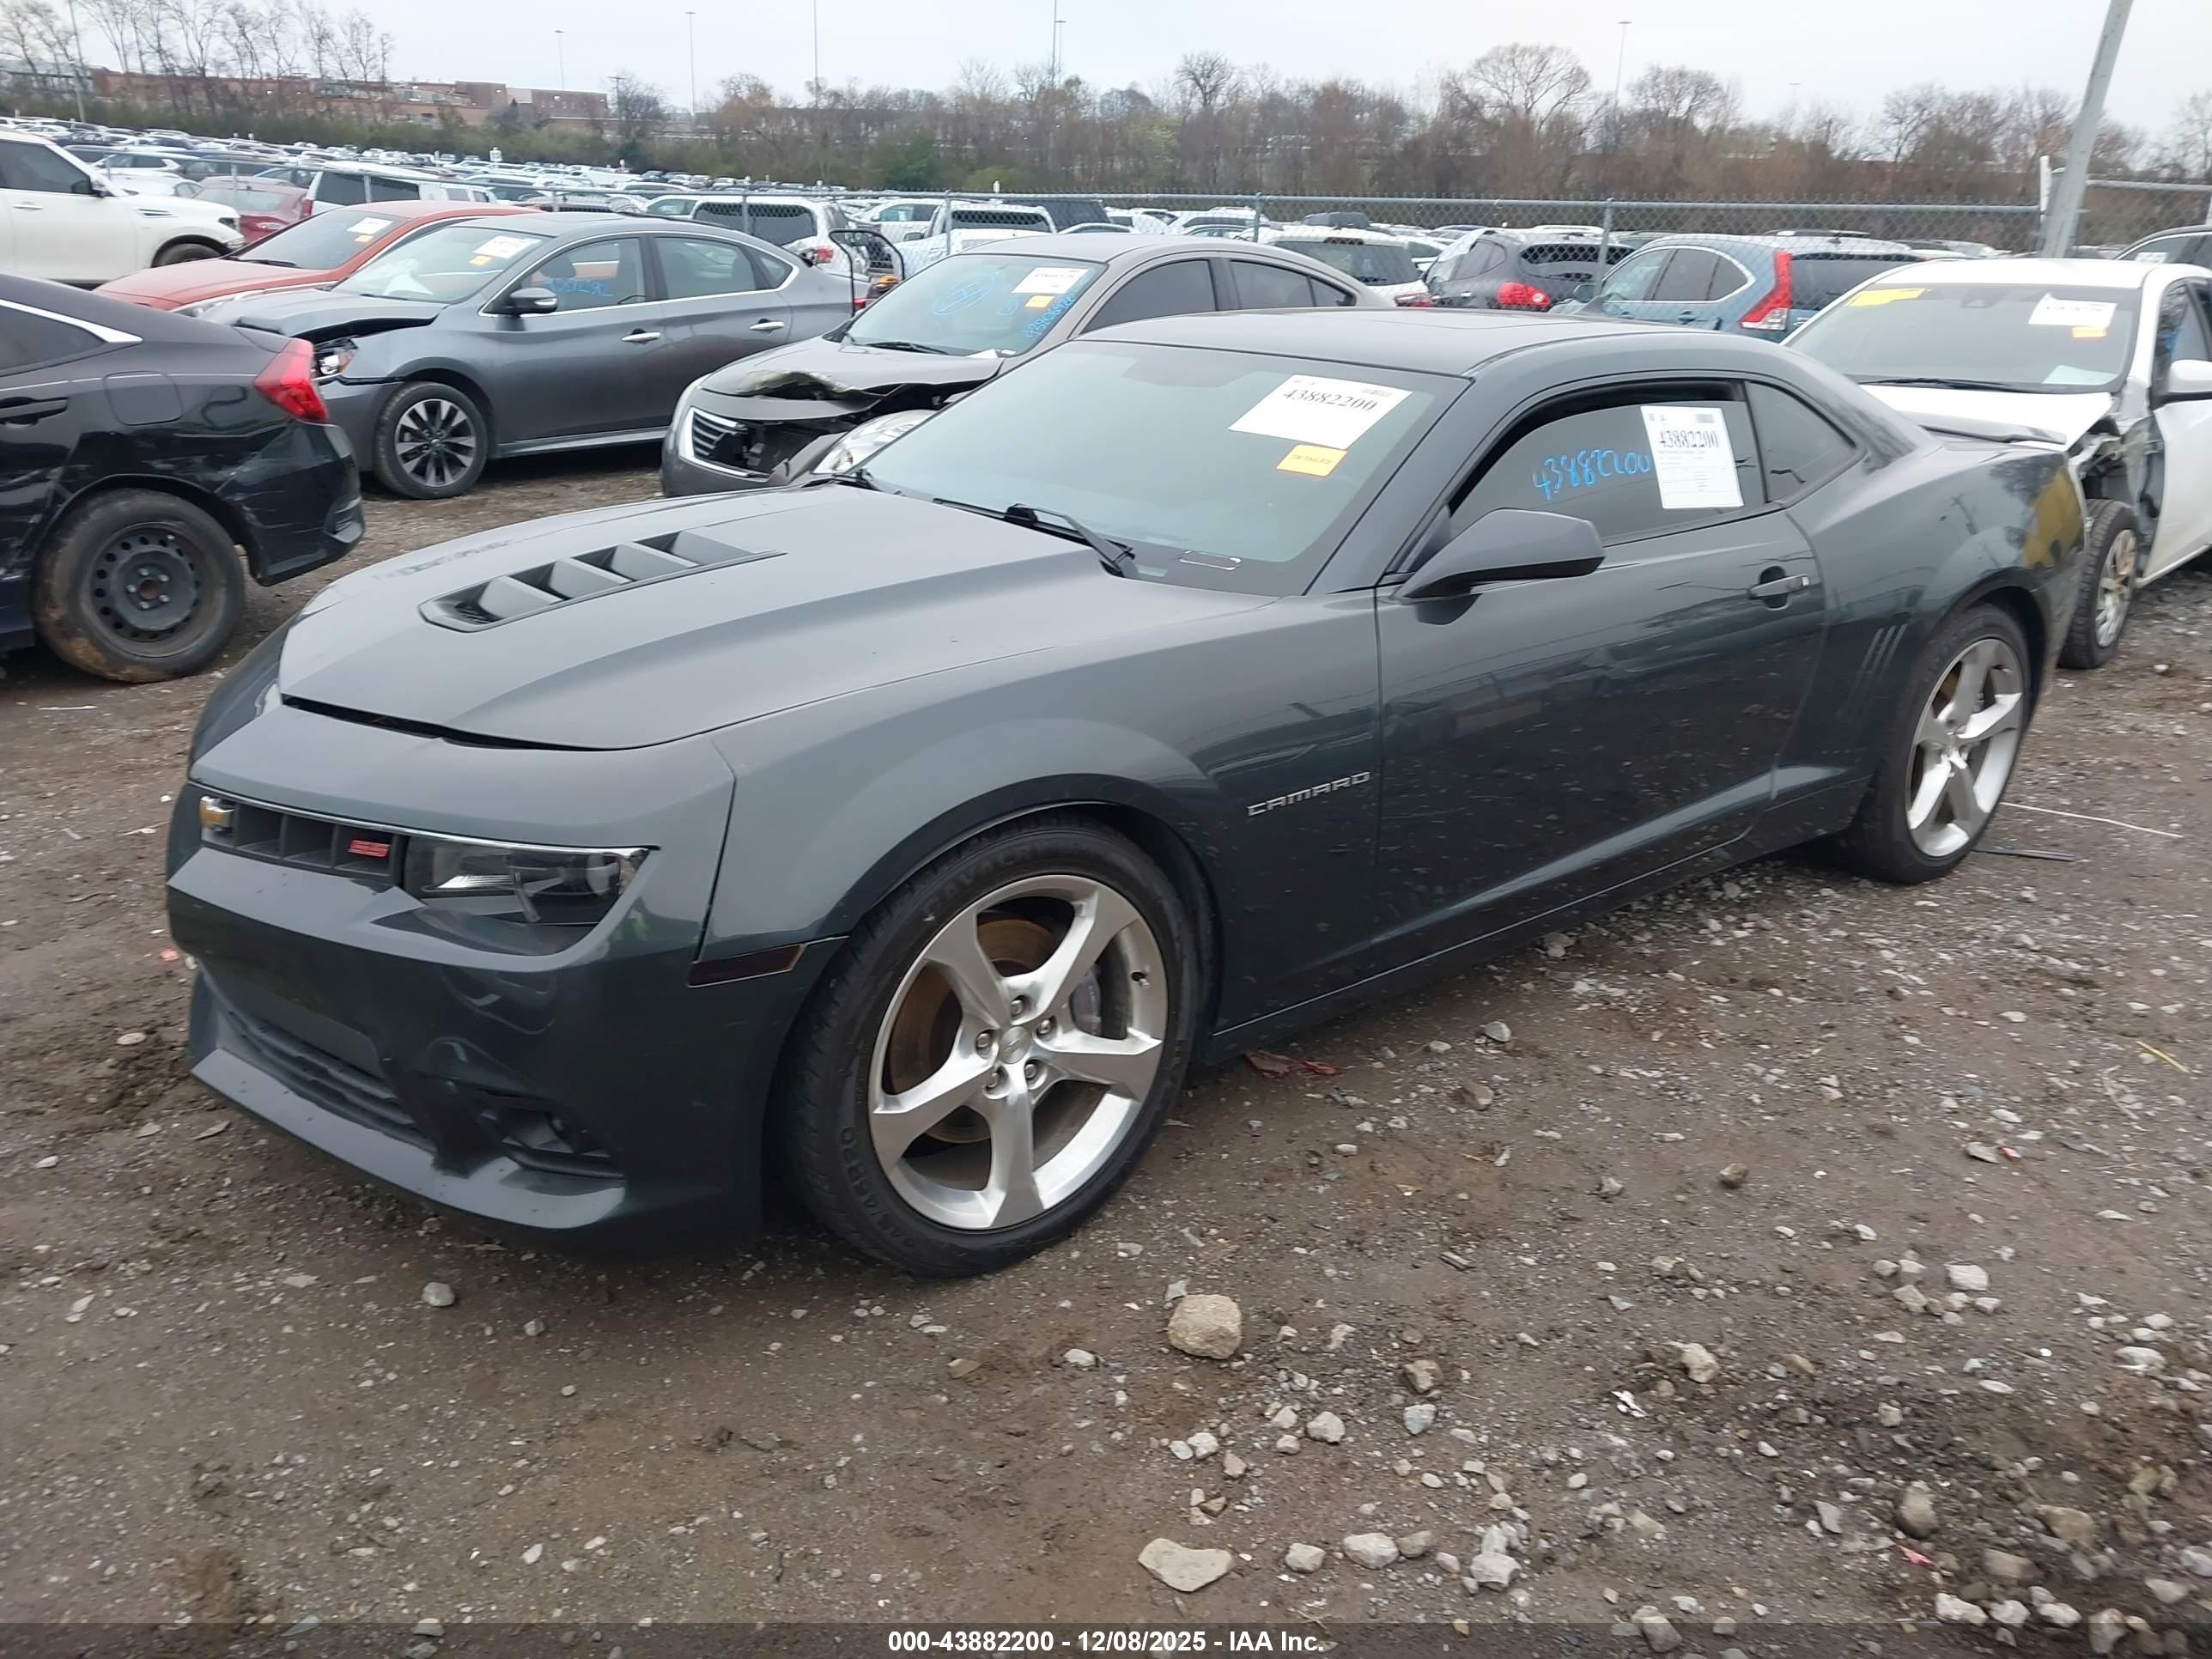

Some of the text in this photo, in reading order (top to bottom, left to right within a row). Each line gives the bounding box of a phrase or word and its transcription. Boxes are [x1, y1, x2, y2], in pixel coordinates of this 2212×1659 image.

[1283, 388, 1378, 411] 43882200
[1658, 429, 1719, 449] 43882200
[1247, 771, 1371, 817] CAMARO
[348, 839, 392, 858] SS
